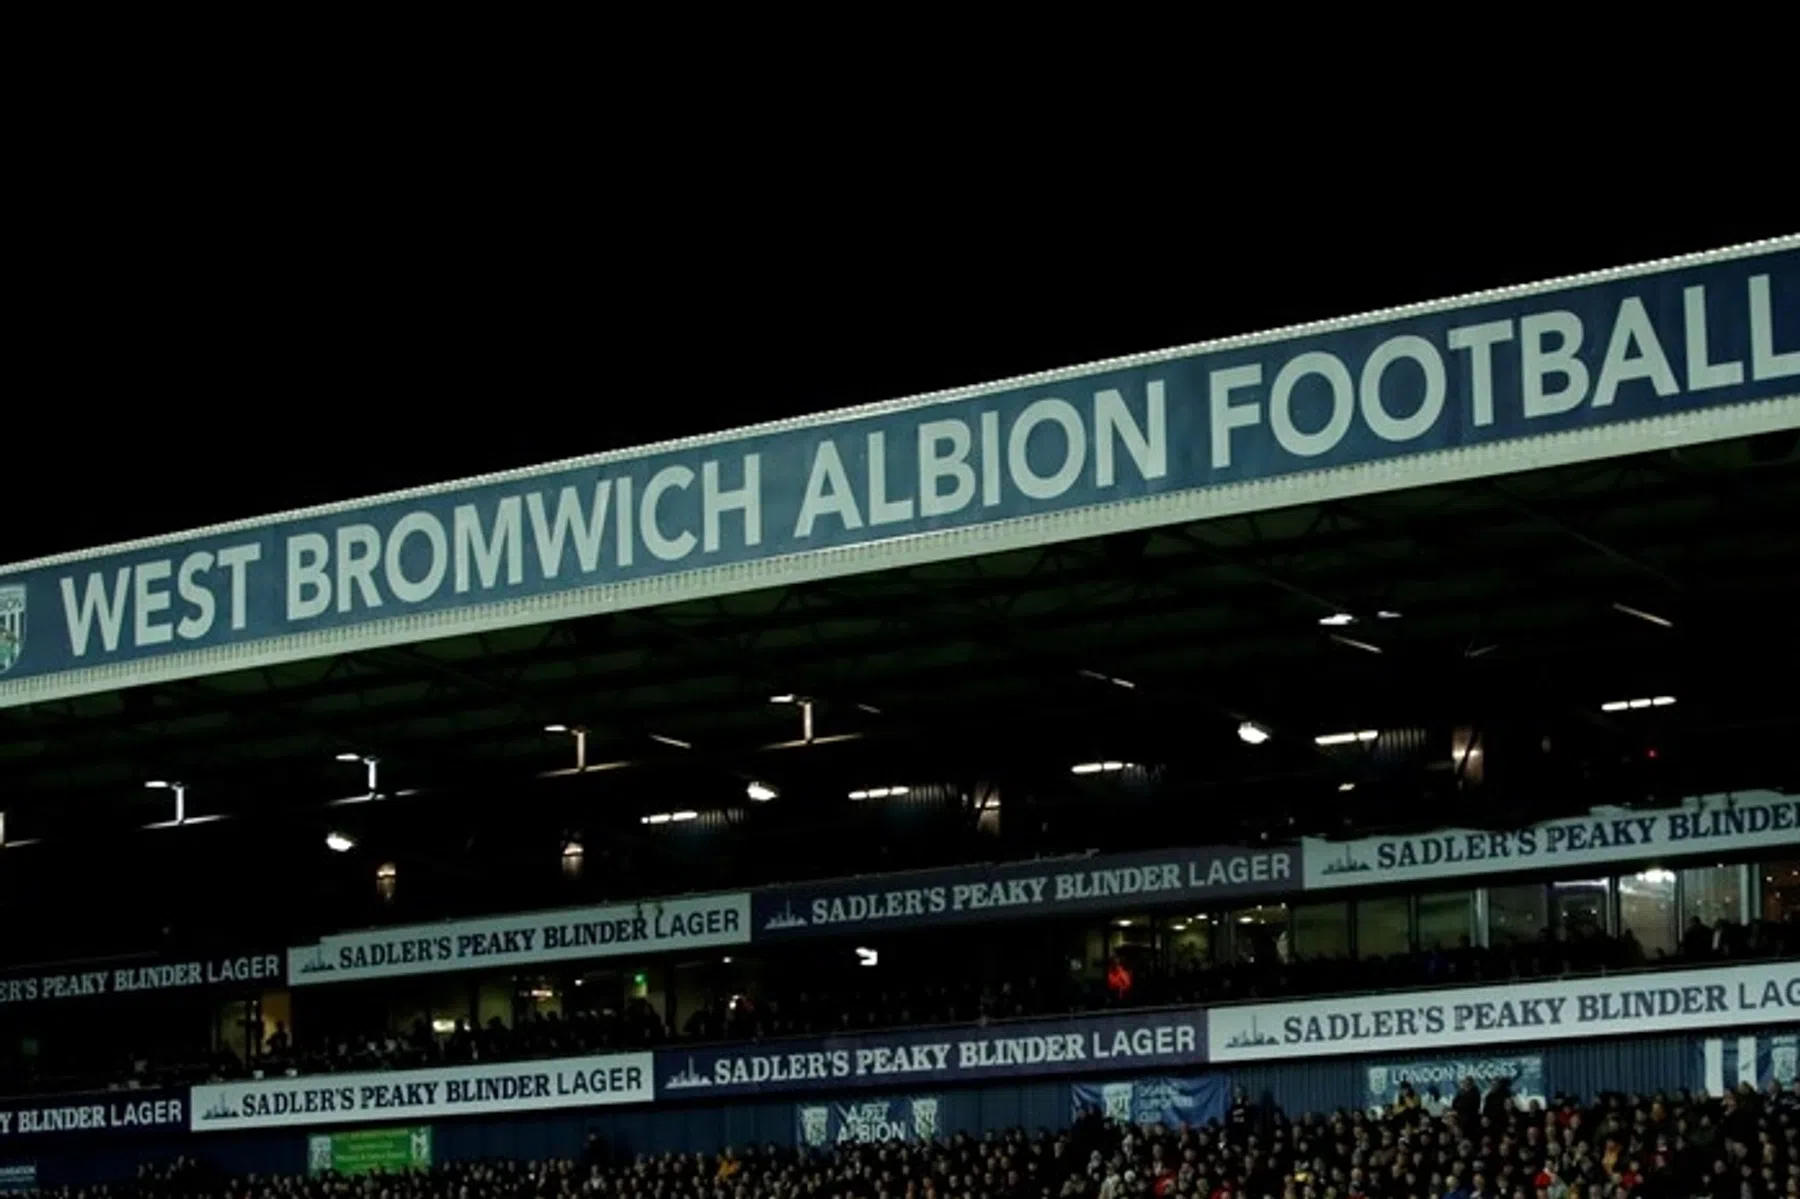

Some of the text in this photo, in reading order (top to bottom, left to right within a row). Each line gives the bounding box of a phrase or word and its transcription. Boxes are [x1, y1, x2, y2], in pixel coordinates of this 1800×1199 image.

[61, 273, 1800, 657] WEST BROMWICH ALBION FOOTBALL
[1377, 801, 1800, 869] SADLER'S PEAKY BLINDE
[811, 853, 1291, 925] SADLER'S PEAKY BLINDER LAGER
[339, 909, 740, 969] SADLER'S PEAKY BLINDER LAGER
[41, 970, 109, 999] PEAKY
[113, 962, 202, 993] BLINDER
[207, 954, 280, 984] LAGER
[1284, 1007, 1444, 1043] SADLER'S
[1454, 996, 1566, 1030] PEAKY
[1577, 985, 1728, 1022] BLINDER
[714, 1026, 1195, 1085] SADLER'S PEAKY BLINDER LAGER
[17, 1103, 107, 1134] BLINDER
[110, 1100, 182, 1128] LAGER
[242, 1067, 642, 1118] SADLER'S PEAKY BLINDER LAGER
